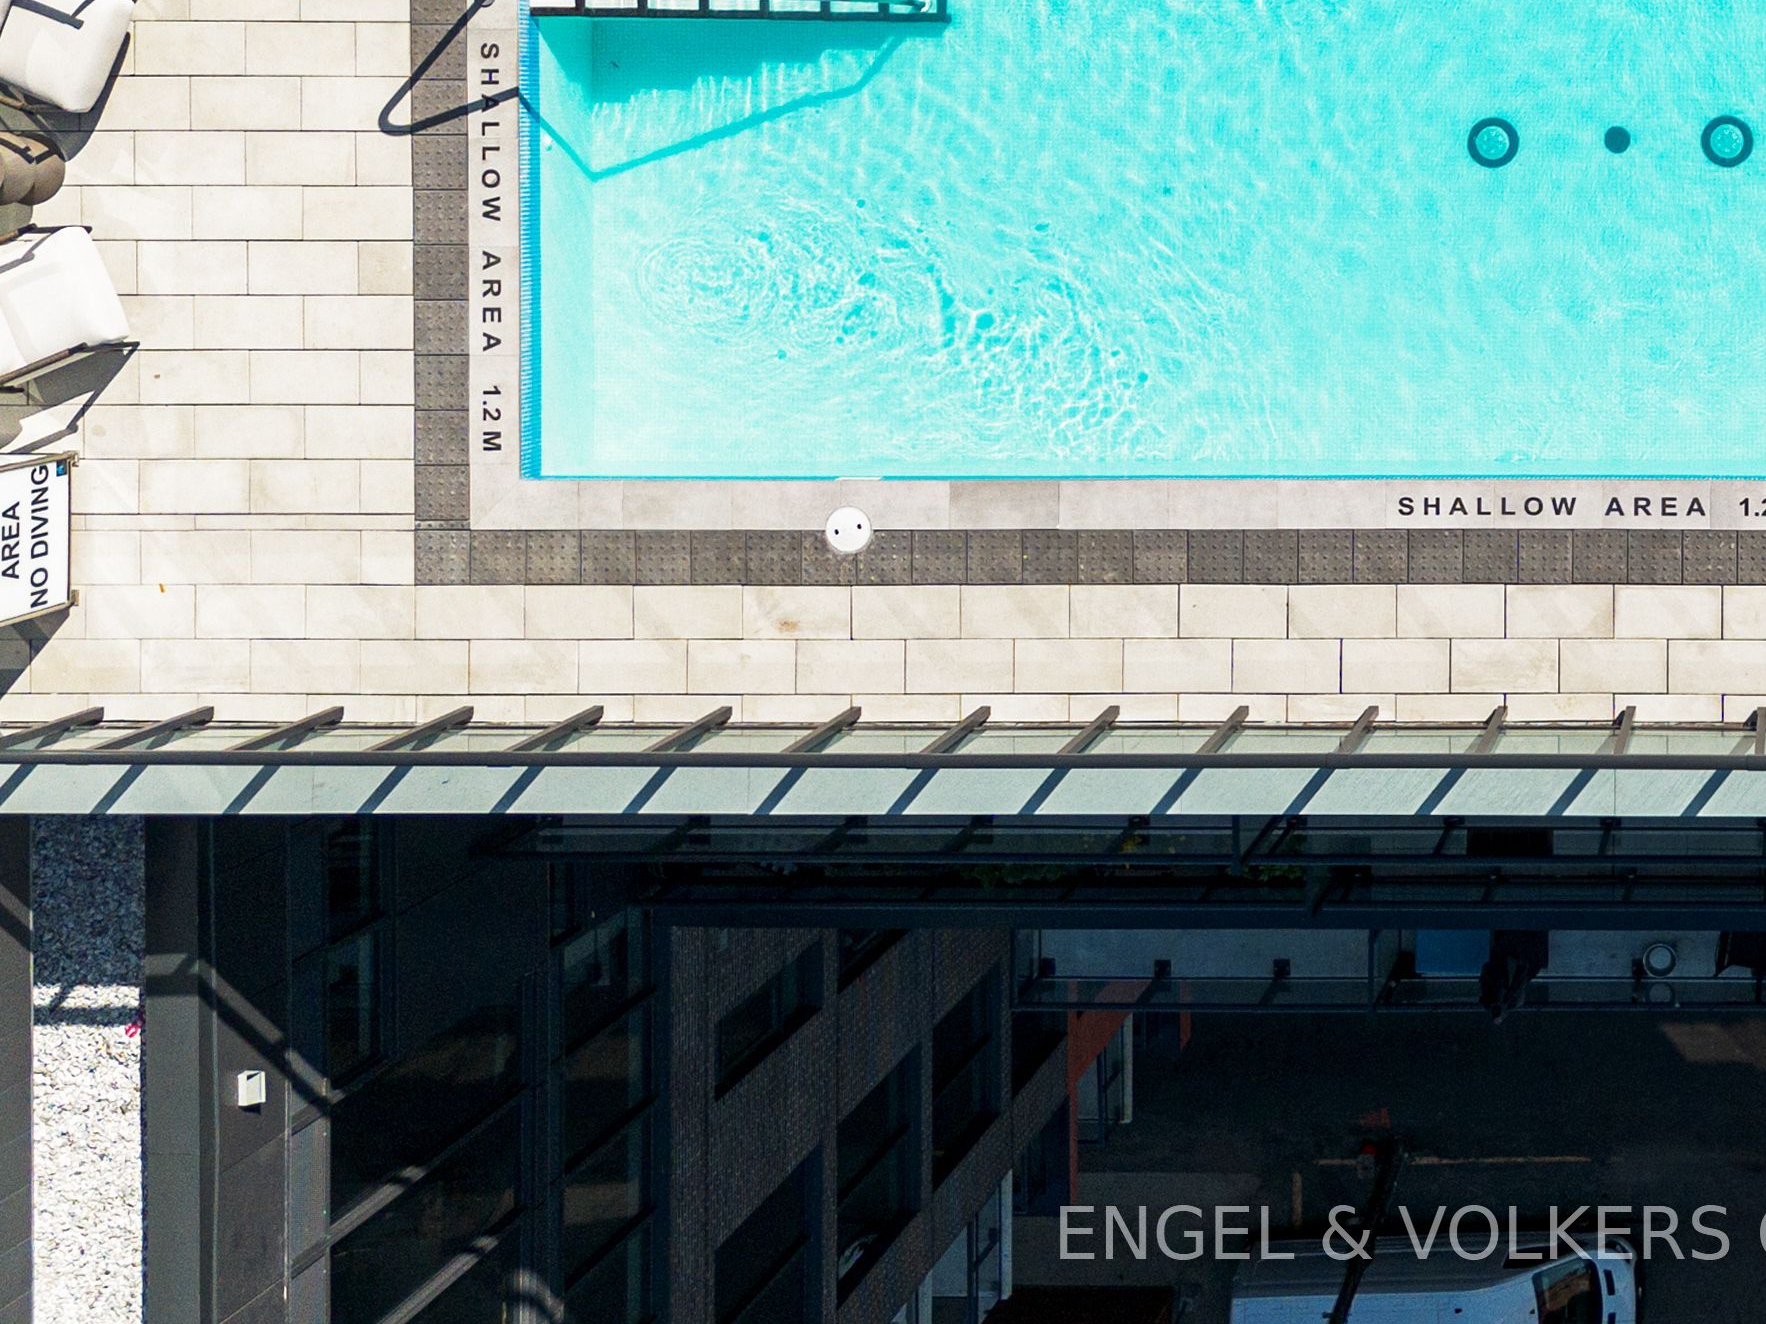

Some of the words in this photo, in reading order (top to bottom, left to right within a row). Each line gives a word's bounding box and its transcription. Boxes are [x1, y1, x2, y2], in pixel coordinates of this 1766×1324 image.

[480, 42, 501, 222] SHALLOW
[482, 250, 502, 352] AREA
[1, 501, 20, 579] AREA
[30, 464, 49, 559] DIVING
[1398, 496, 1577, 516] SHALLOW
[1604, 496, 1706, 517] AREA
[30, 566, 49, 608] NO
